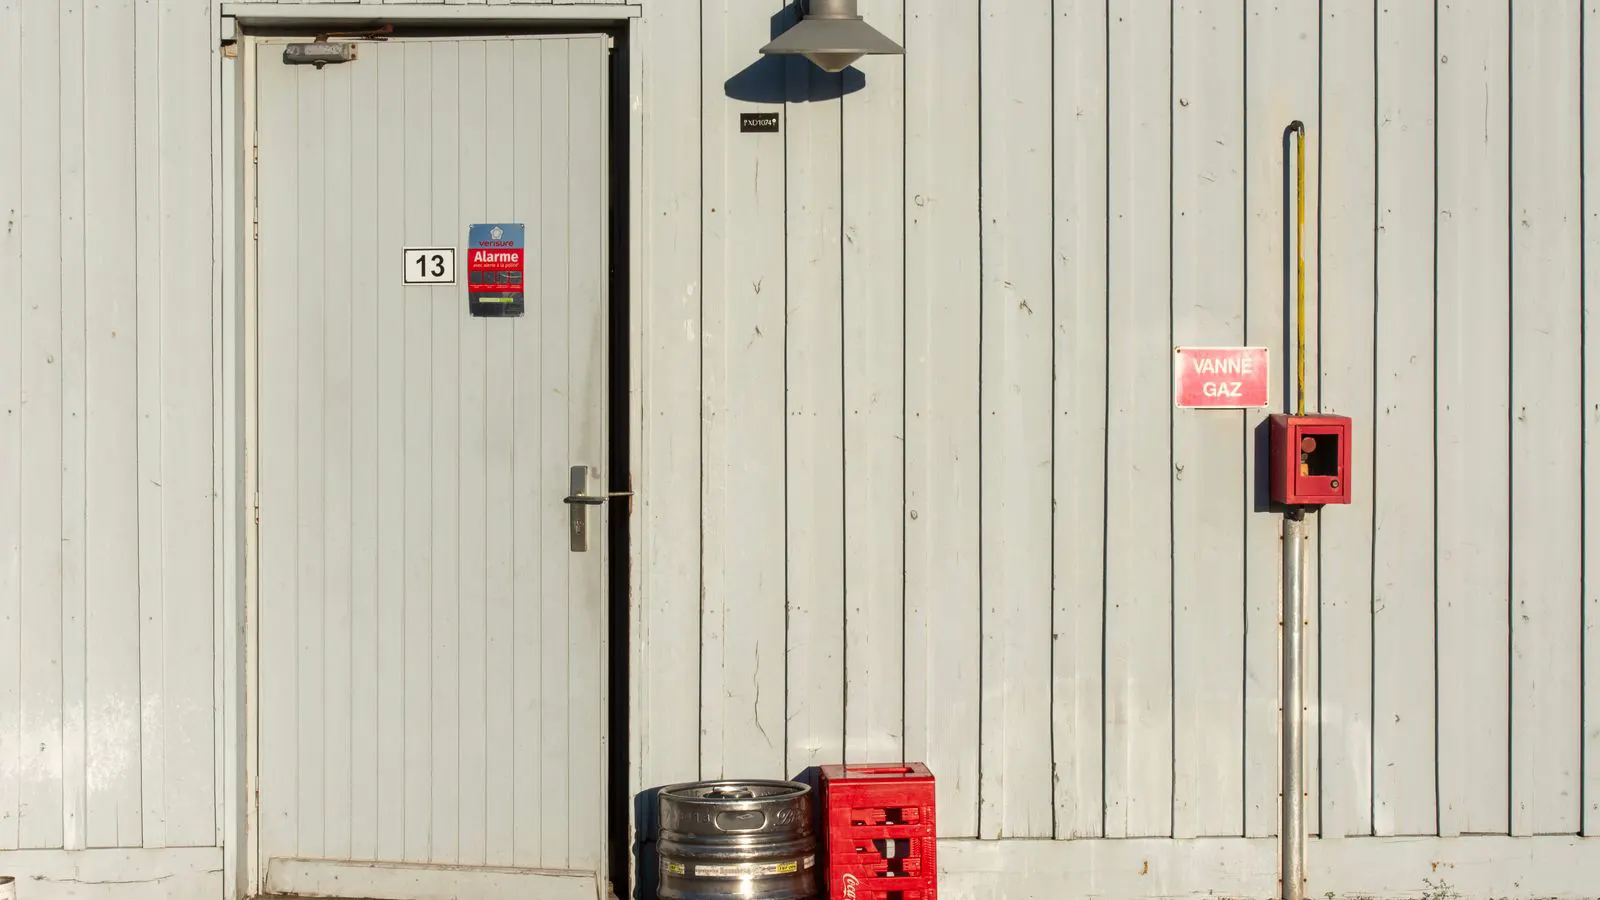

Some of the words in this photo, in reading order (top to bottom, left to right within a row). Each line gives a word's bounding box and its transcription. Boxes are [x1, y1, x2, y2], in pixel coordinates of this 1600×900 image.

[474, 250, 519, 262] Alarme
[416, 254, 445, 277] 13
[1193, 358, 1253, 374] VANNE
[1202, 381, 1243, 397] GAZ
